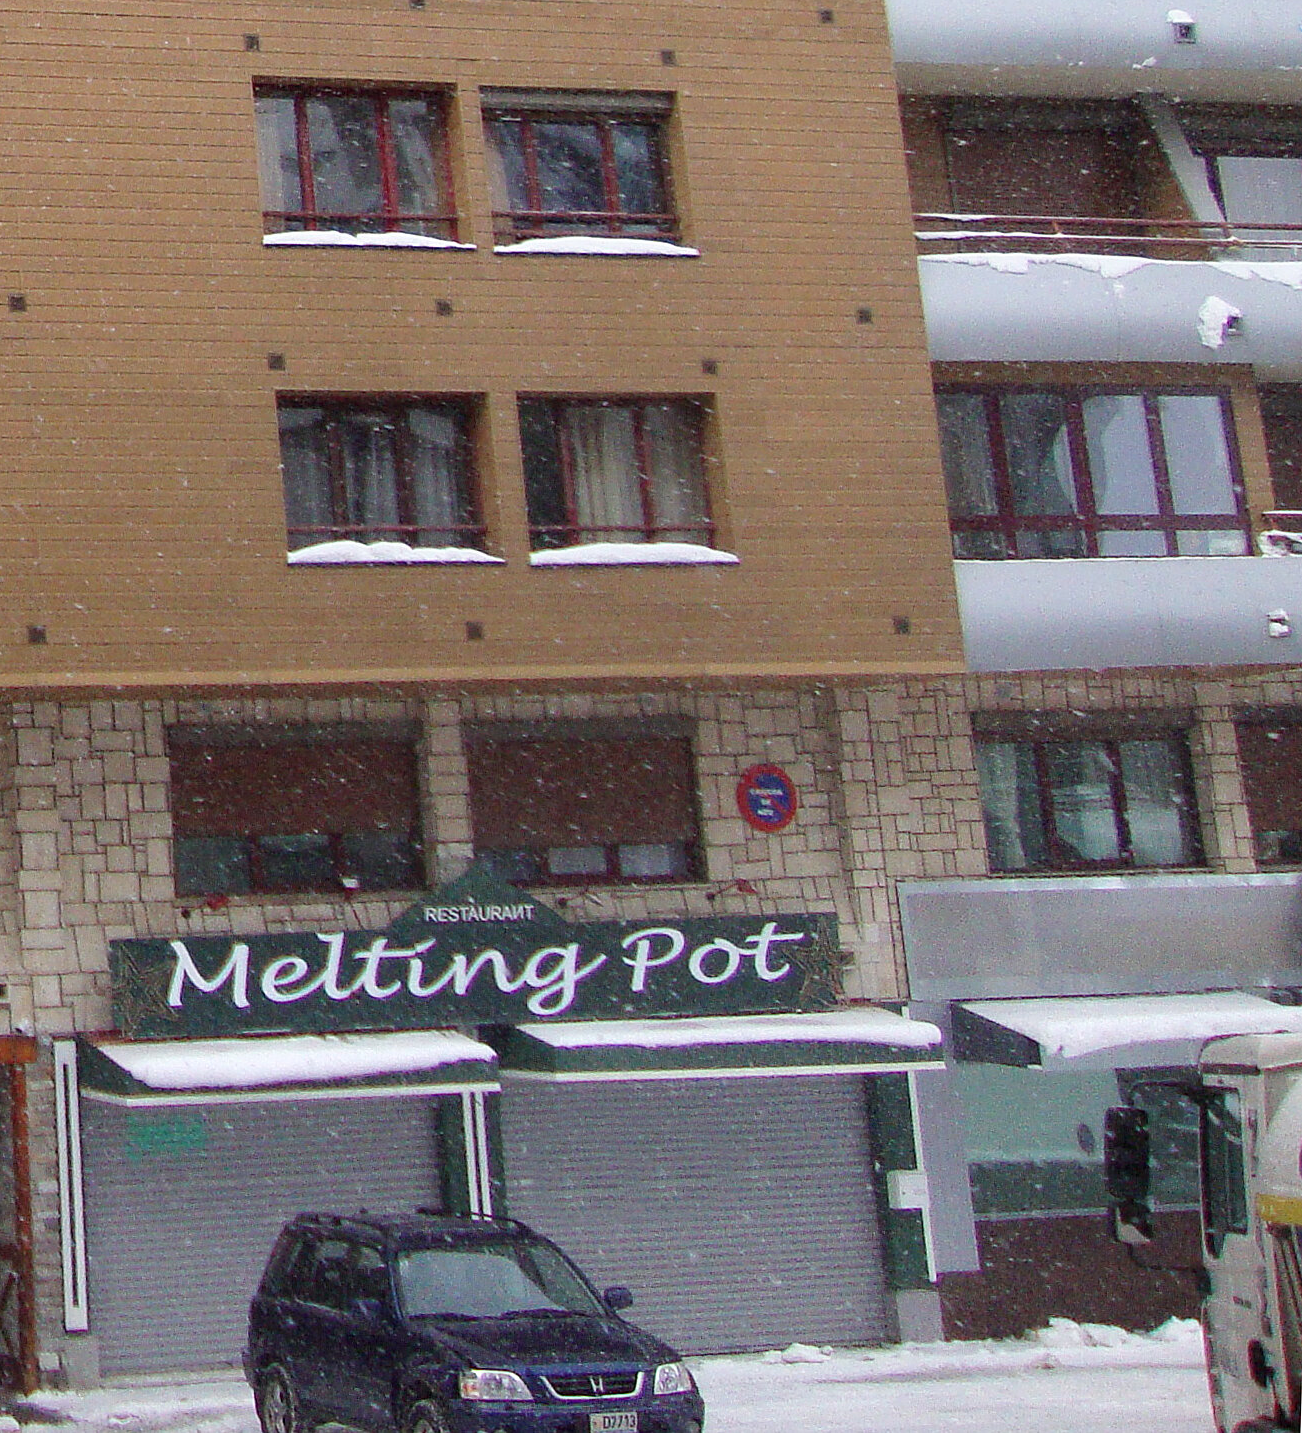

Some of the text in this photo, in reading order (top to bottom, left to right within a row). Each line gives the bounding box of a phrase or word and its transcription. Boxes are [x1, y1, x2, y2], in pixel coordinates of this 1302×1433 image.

[424, 904, 534, 922] RESTAURANT
[167, 921, 805, 1016] Melting Pot
